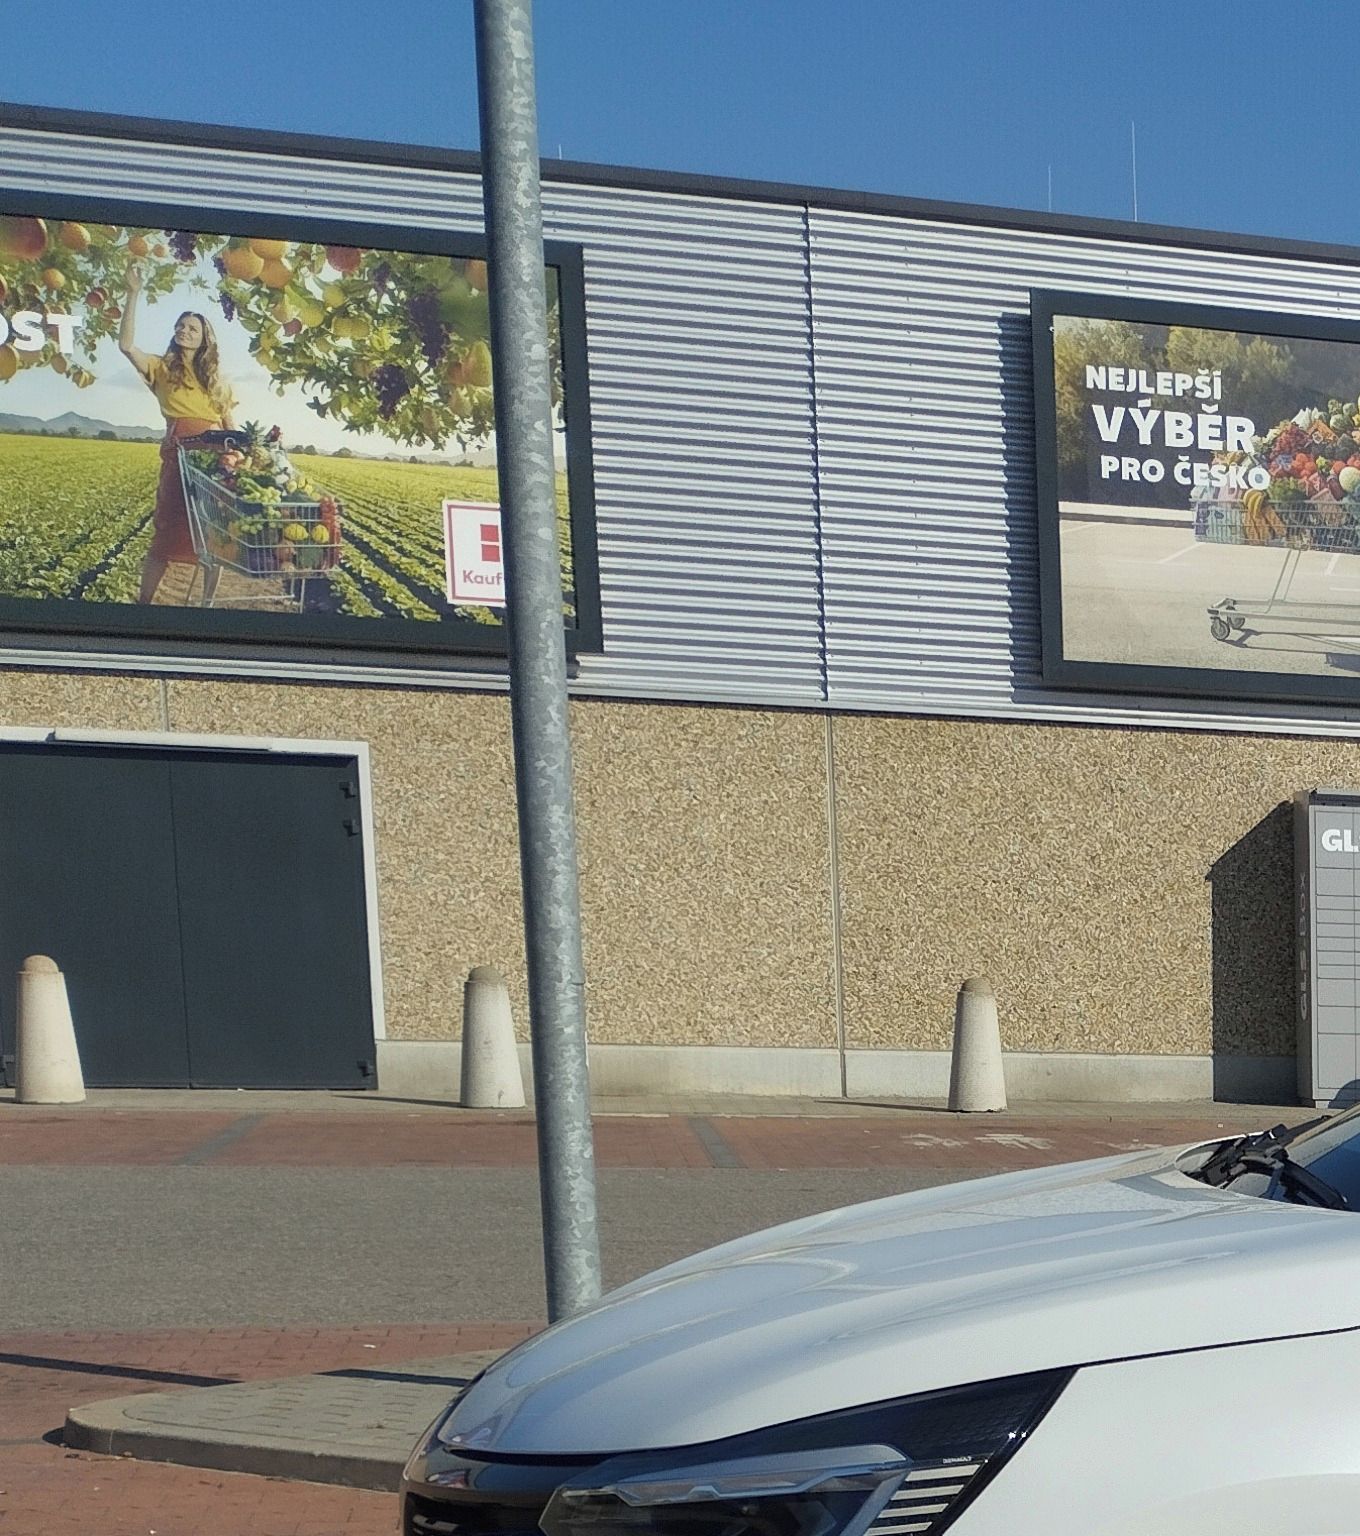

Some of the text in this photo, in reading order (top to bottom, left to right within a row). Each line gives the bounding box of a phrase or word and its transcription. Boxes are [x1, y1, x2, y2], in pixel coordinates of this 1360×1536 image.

[1084, 364, 1223, 401] NEJLEPŠÍ
[1091, 399, 1256, 454] VÝBĚR
[1100, 454, 1271, 491] PRO ČESKO
[462, 569, 503, 585] Kauf
